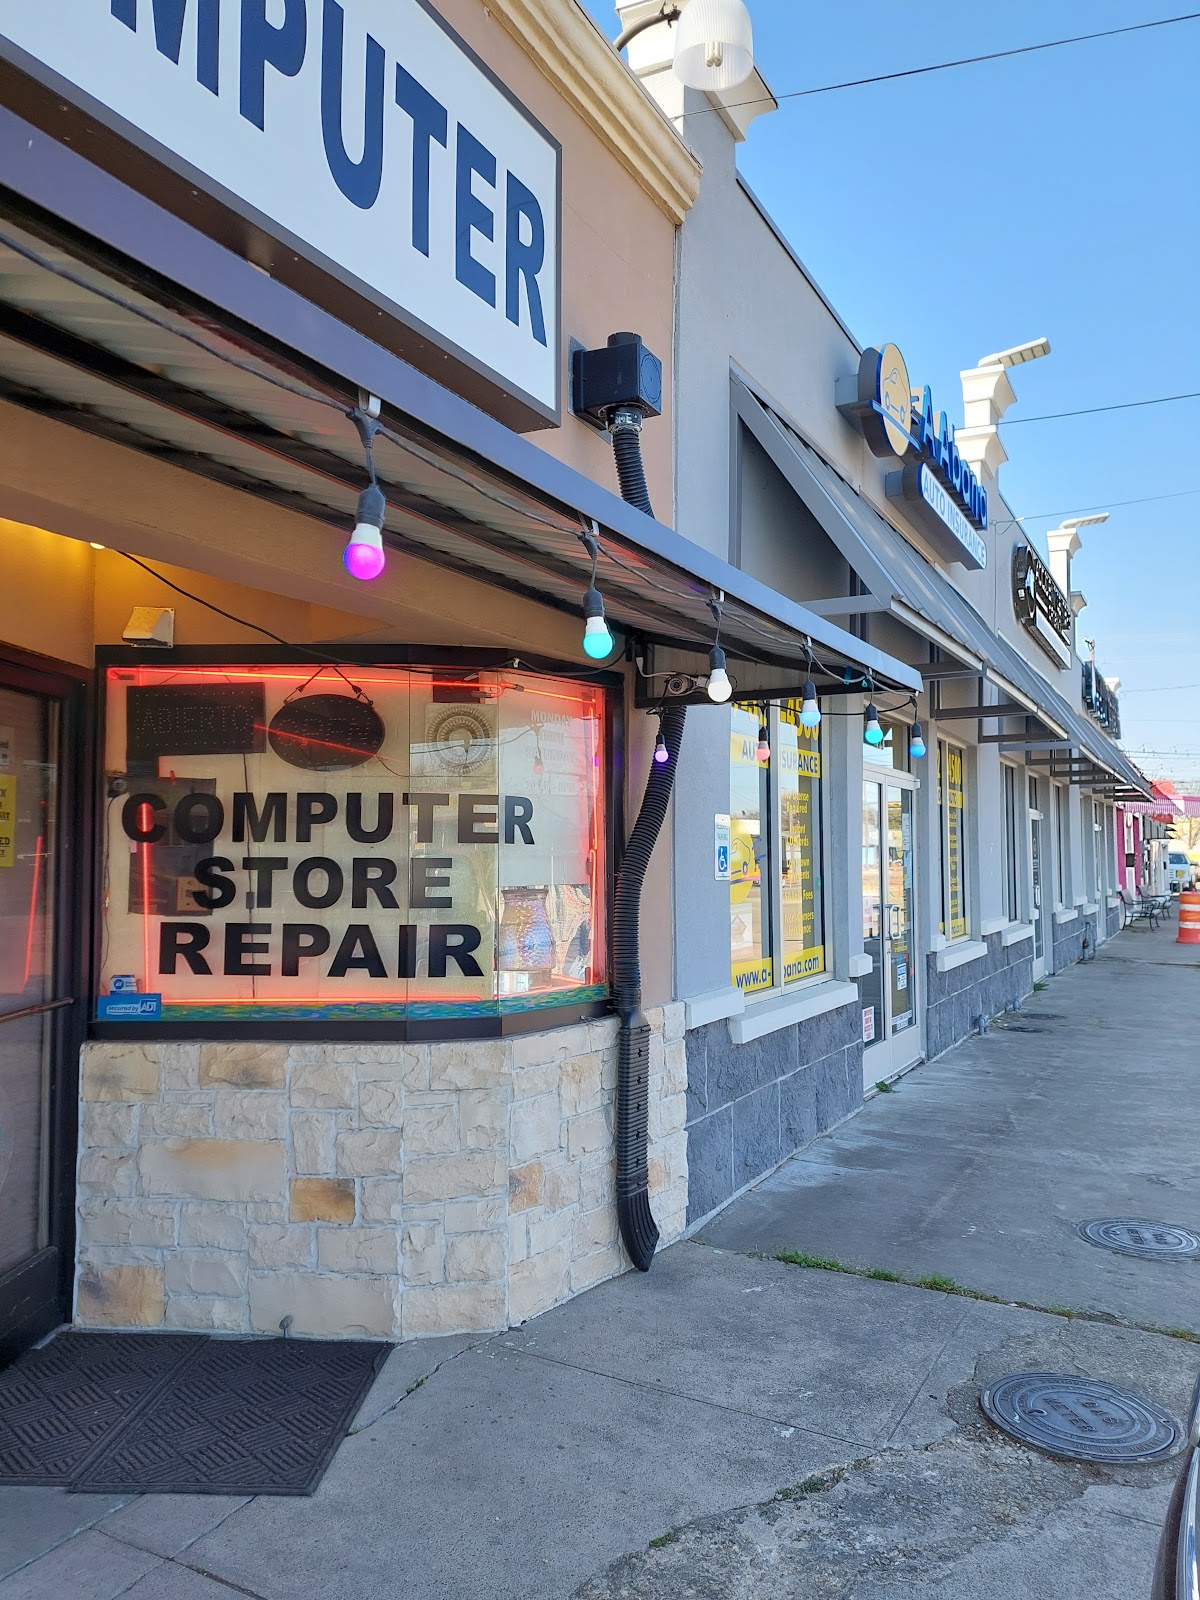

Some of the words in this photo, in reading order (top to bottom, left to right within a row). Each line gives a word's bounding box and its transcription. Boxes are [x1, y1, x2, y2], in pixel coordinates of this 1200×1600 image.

[924, 473, 946, 513] AUTO
[947, 499, 985, 567] INSURANCE
[139, 705, 250, 734] ABIERTO
[780, 749, 818, 774] SURANCE
[121, 792, 535, 845] COMPUTER
[193, 856, 453, 910] STORE
[159, 922, 484, 978] REPAIR
[141, 1001, 156, 1012] ADT
